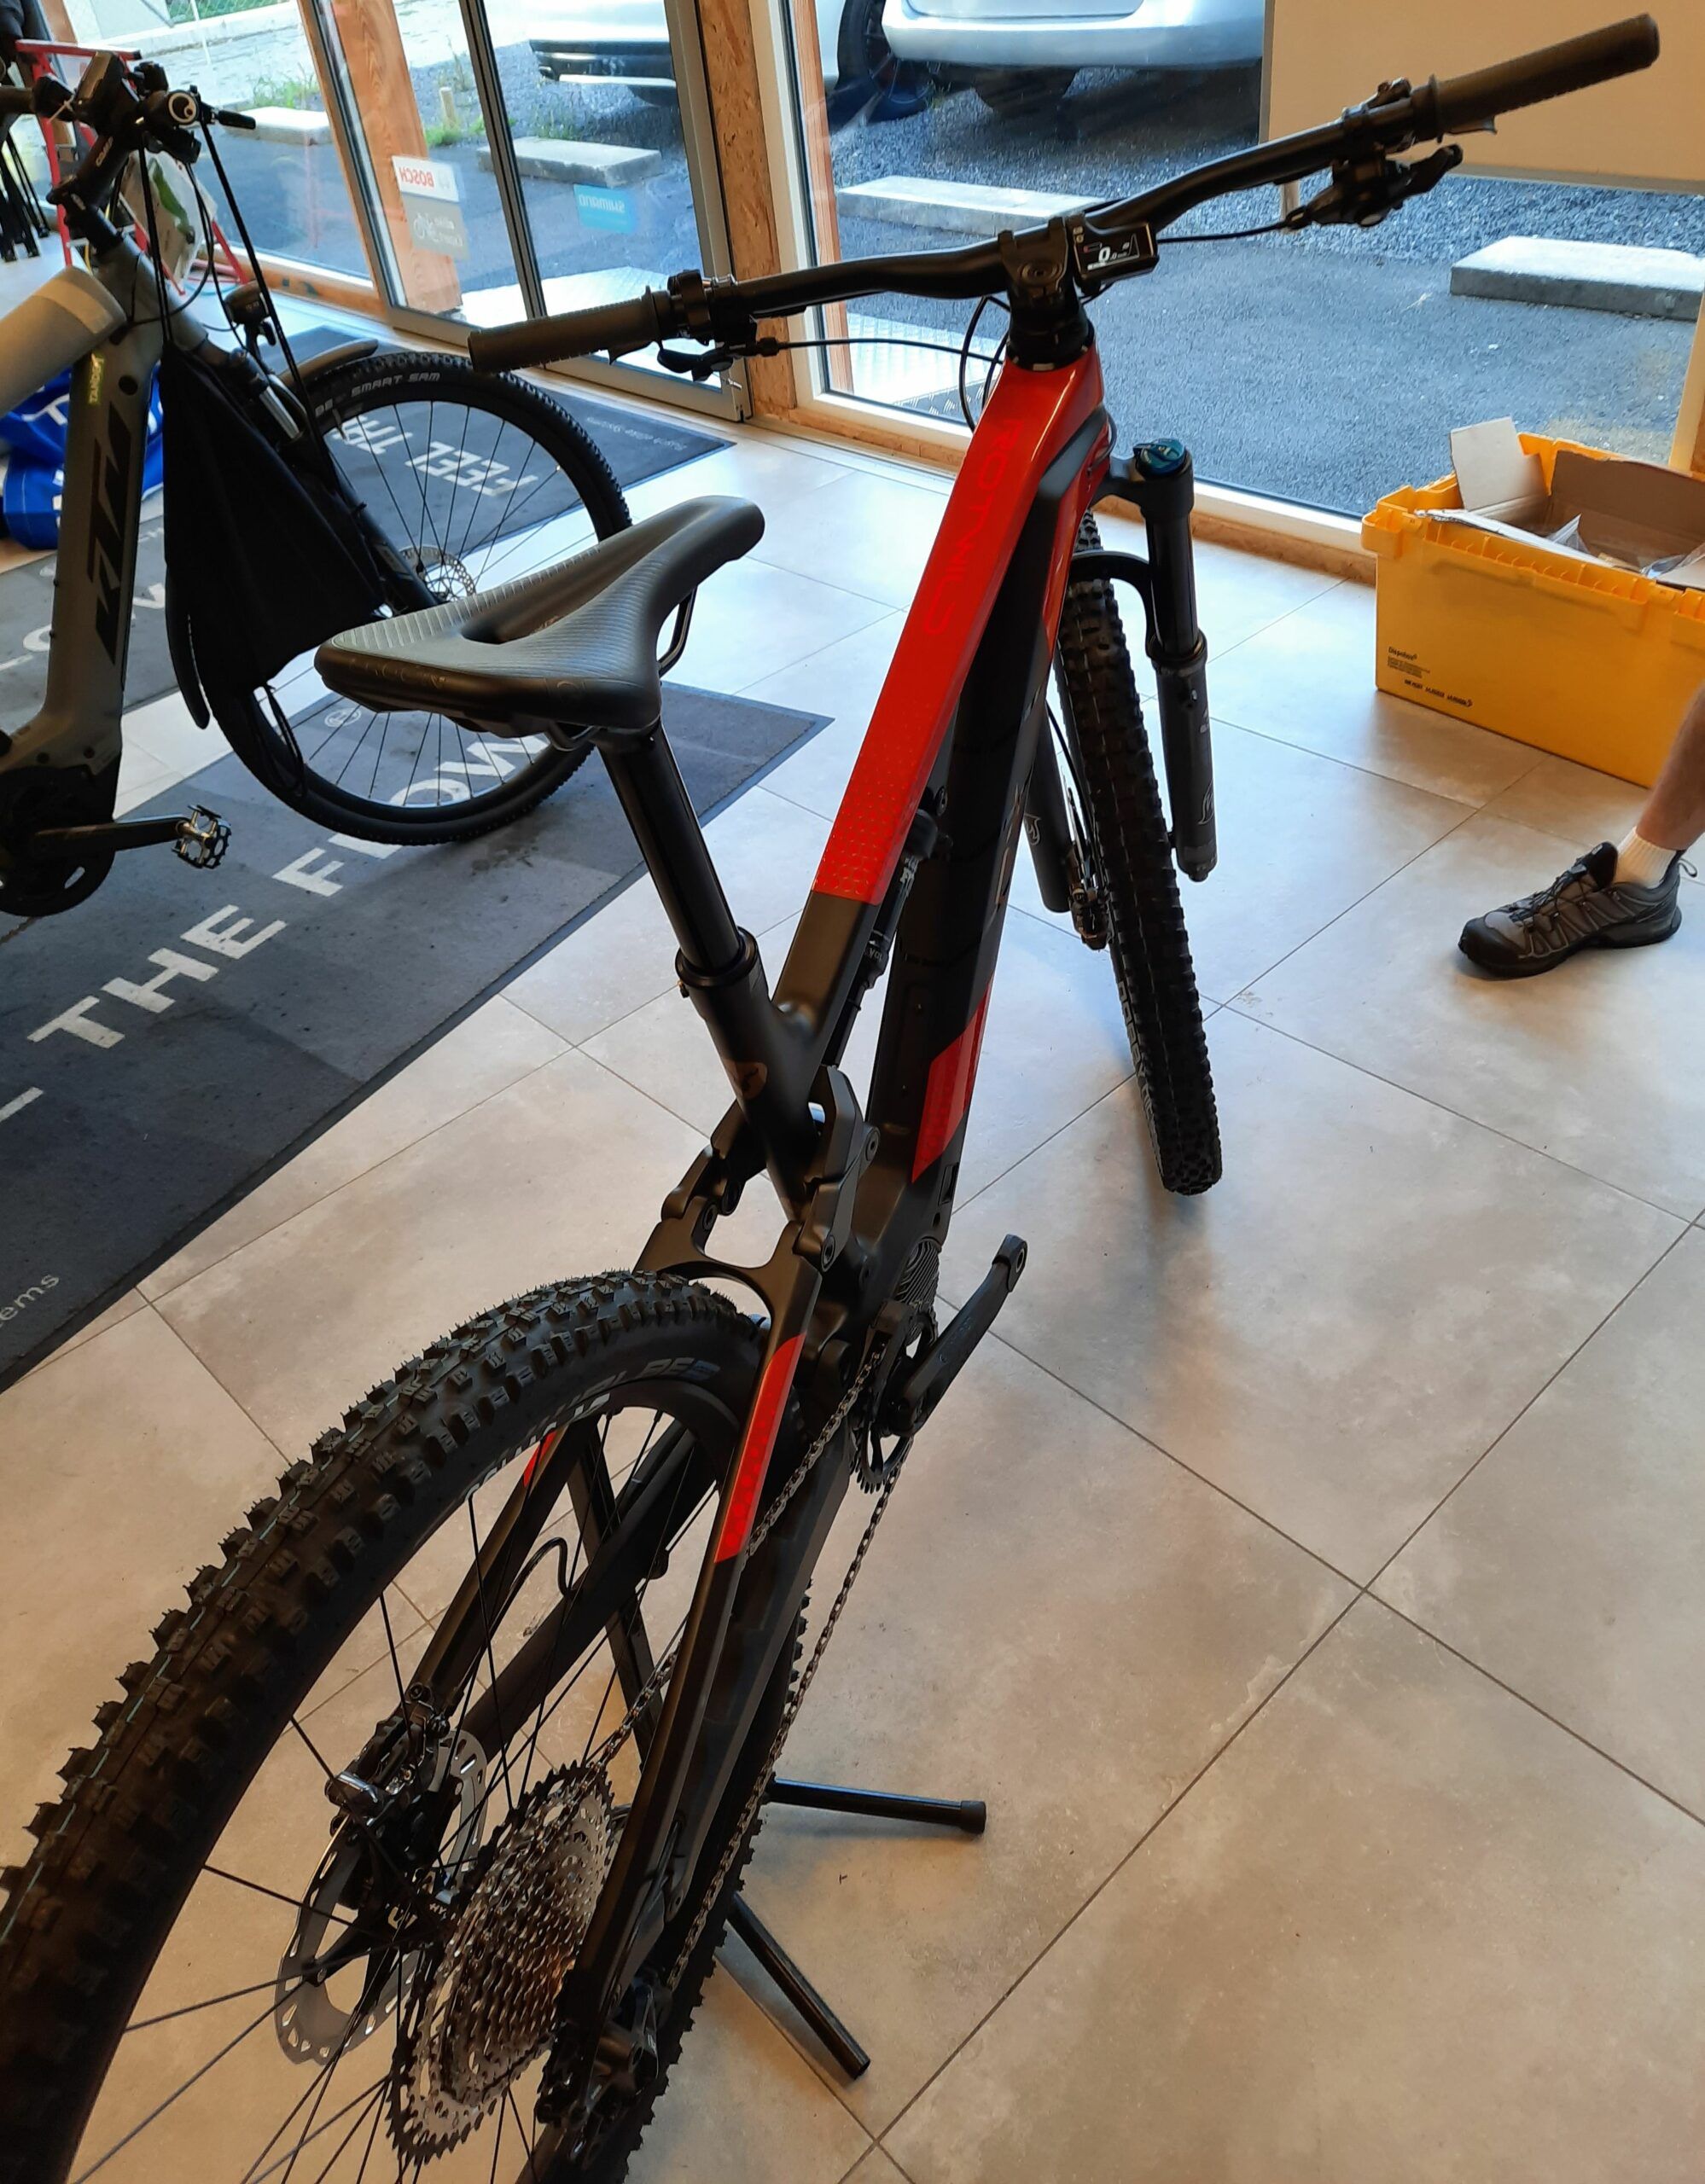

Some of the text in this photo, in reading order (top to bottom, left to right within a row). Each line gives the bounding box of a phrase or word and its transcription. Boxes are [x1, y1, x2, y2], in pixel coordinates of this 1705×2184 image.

[351, 372, 440, 398] SMART SAM
[404, 440, 538, 497] FEEL
[923, 420, 1022, 636] ROTWILD
[27, 904, 288, 1048] THE
